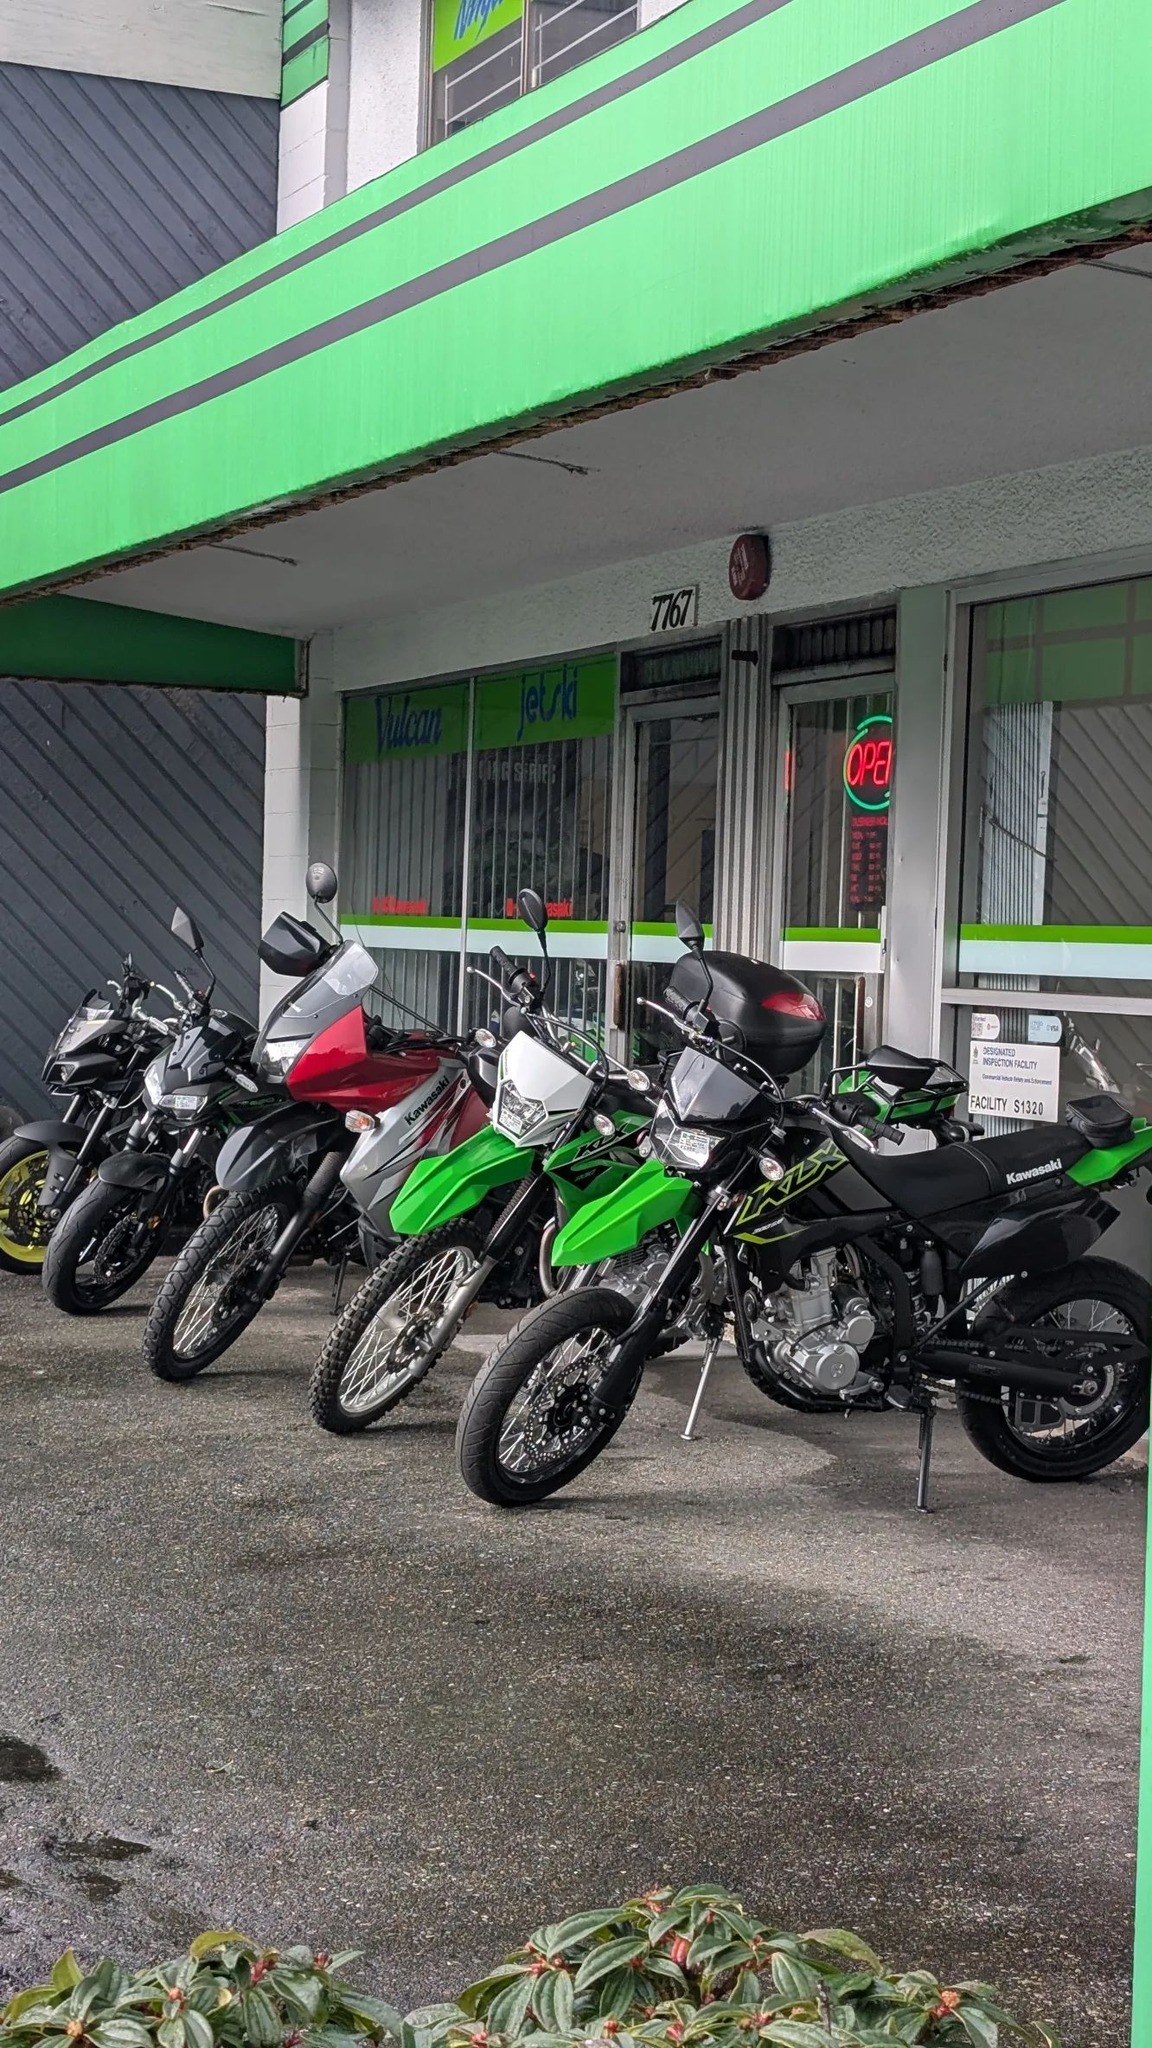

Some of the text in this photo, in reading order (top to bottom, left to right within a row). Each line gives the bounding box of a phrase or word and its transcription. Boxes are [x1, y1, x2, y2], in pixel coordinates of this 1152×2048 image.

[651, 589, 693, 631] 7767
[374, 694, 442, 756] Vulcan
[982, 1046, 1015, 1057] DESIGNATED
[982, 1057, 1013, 1068] INSPECTION
[1014, 1060, 1038, 1070] FACILITY
[404, 1075, 450, 1126] Kawasaki
[970, 1094, 1044, 1116] FACILITY S1320
[735, 1137, 849, 1227] KLX
[1005, 1157, 1063, 1185] Kawasaki
